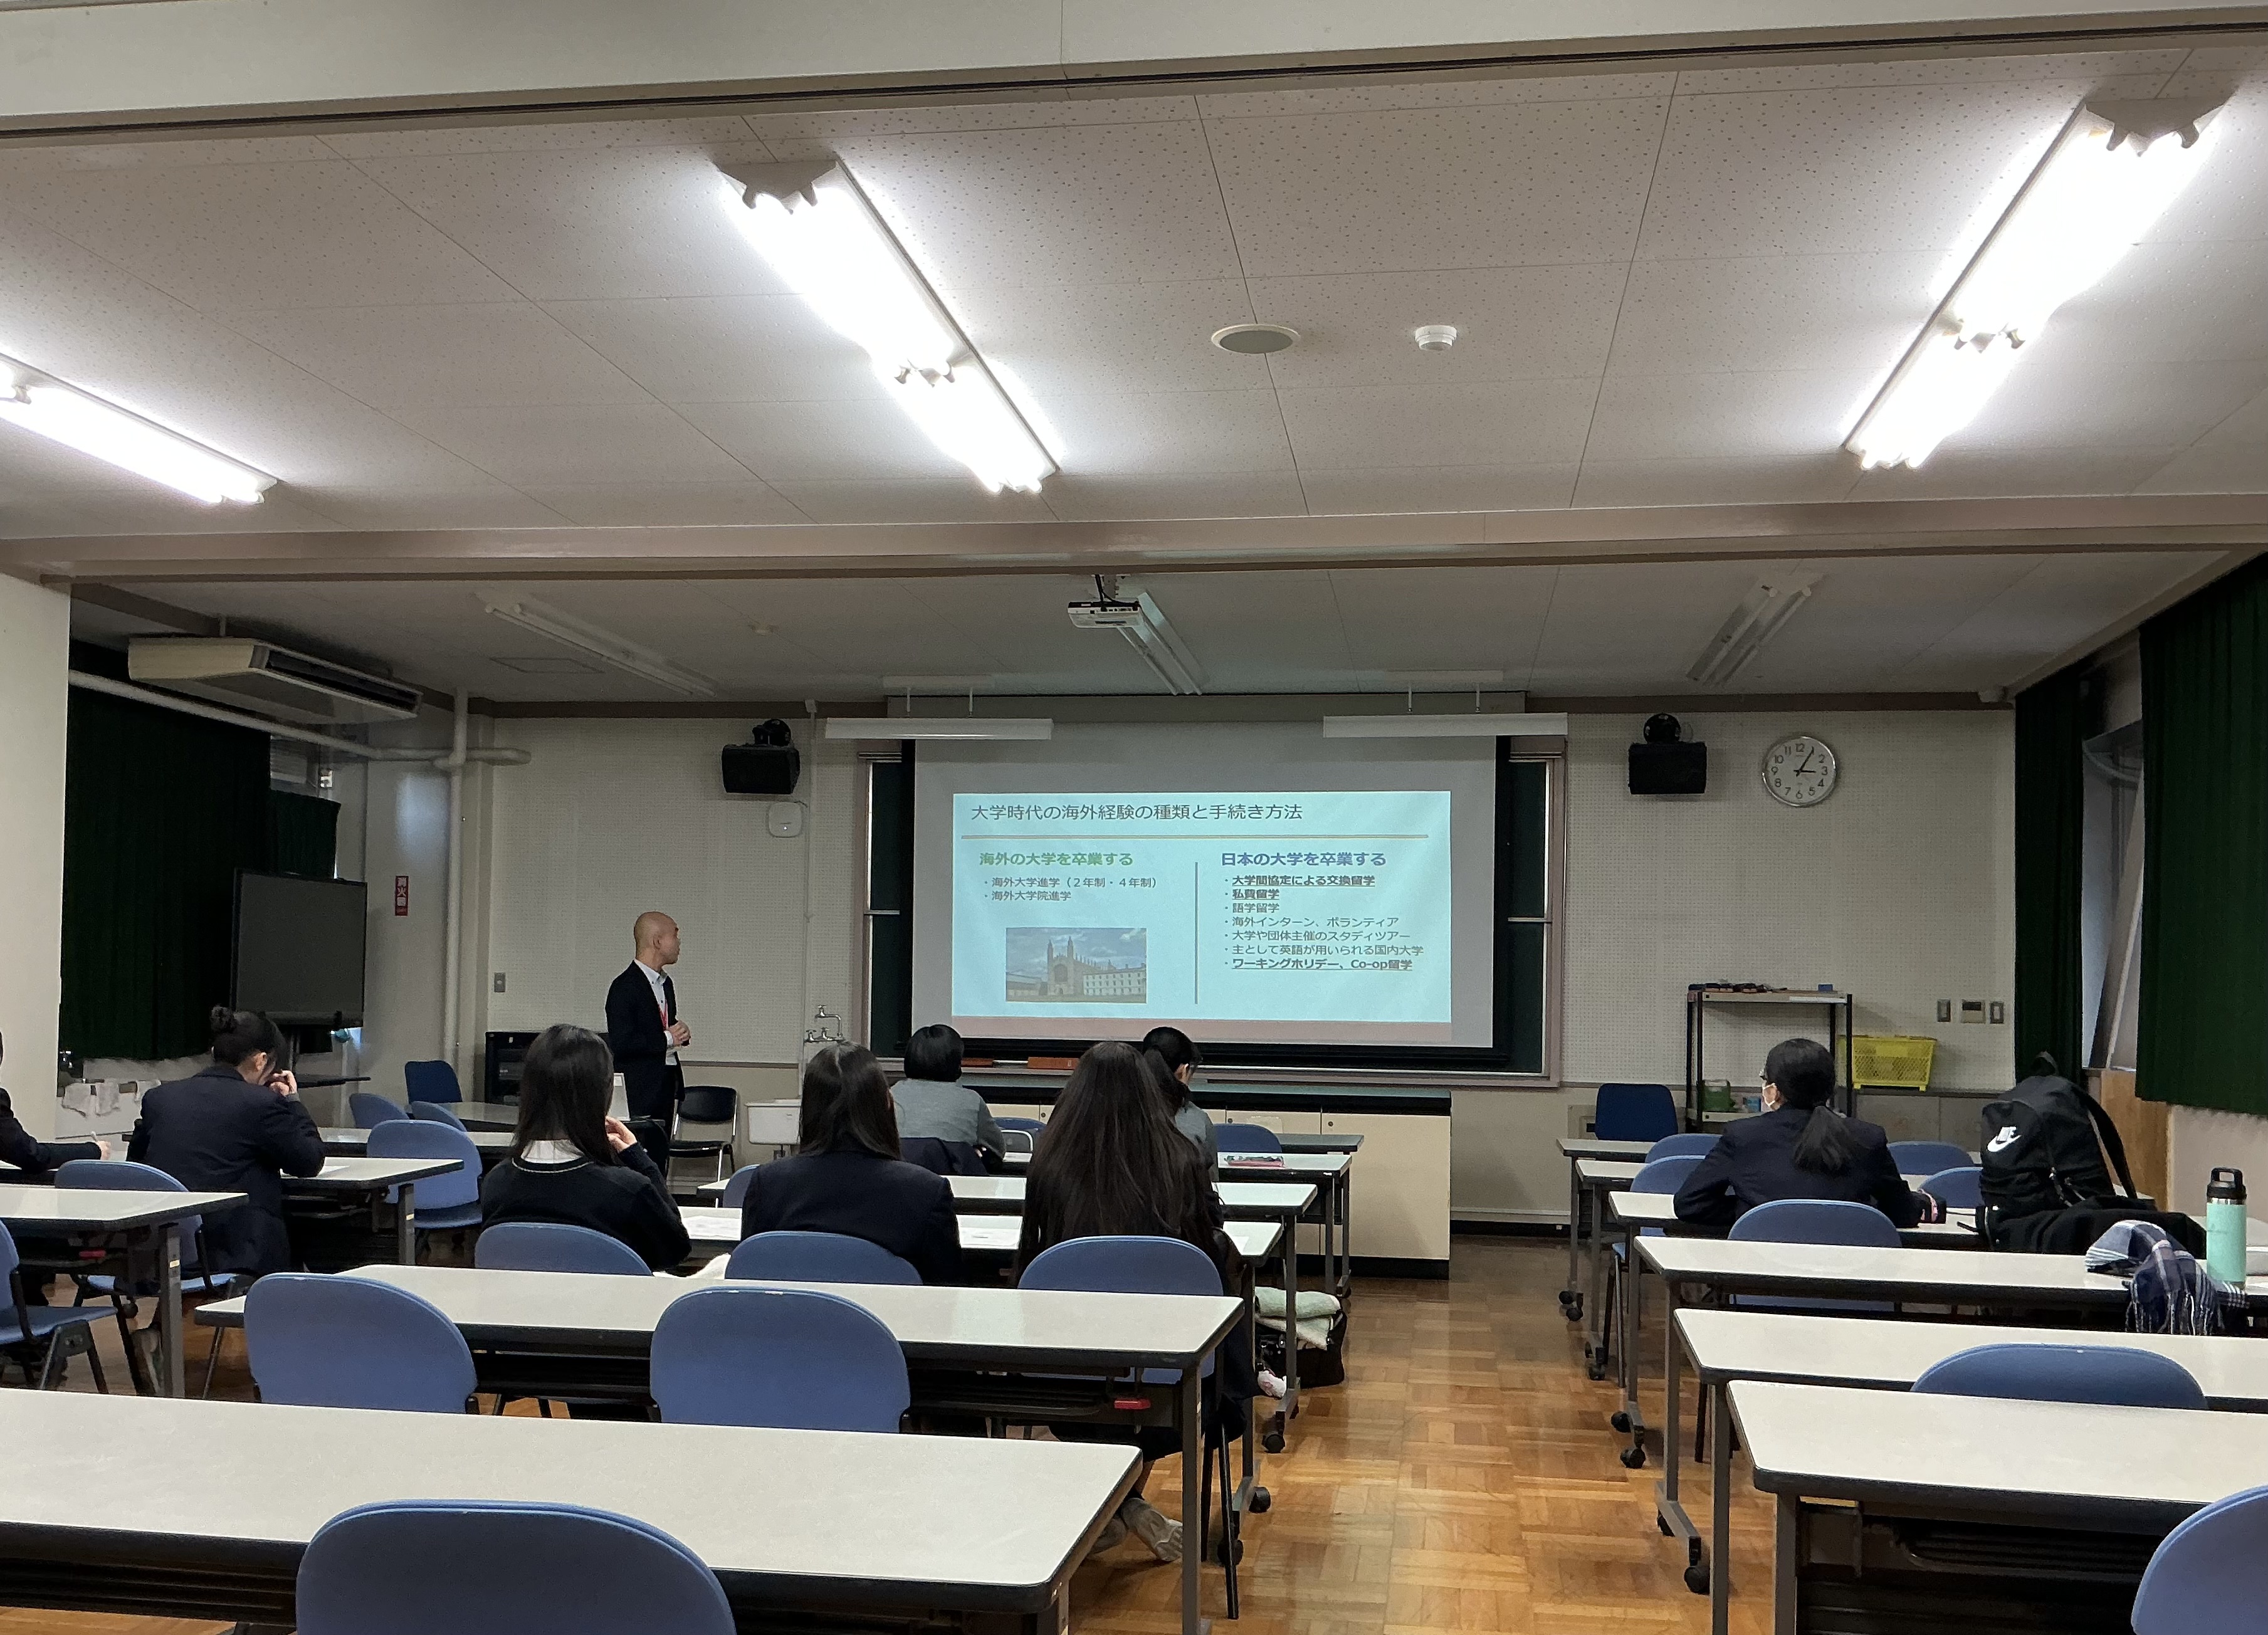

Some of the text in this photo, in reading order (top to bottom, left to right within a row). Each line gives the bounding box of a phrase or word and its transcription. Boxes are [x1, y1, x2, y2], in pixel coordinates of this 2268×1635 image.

[1785, 745, 1792, 756] 11
[1795, 743, 1805, 752] 12
[1774, 754, 1784, 764] 10
[1819, 754, 1825, 763] 2
[1771, 766, 1778, 775] 9
[1821, 766, 1828, 775] 3
[1774, 778, 1782, 788] 8
[1818, 779, 1824, 787] 4
[1785, 787, 1792, 796] 7
[1795, 790, 1803, 799] 6
[1808, 787, 1815, 796] 5
[972, 804, 1303, 821] 大学時代の海外経験の種類と手続き方法
[979, 852, 1133, 866] 海外の大学を卒業する
[1222, 852, 1387, 866] 日本の大学を卒業する
[992, 891, 1071, 902] 海外大学院進学
[1232, 889, 1280, 900] 私費留学
[1232, 903, 1280, 913] 語学留学
[1232, 930, 1410, 942] 大学や団体主催のスタディツアー
[1232, 944, 1424, 957] 主として英語が用いられる国内大学
